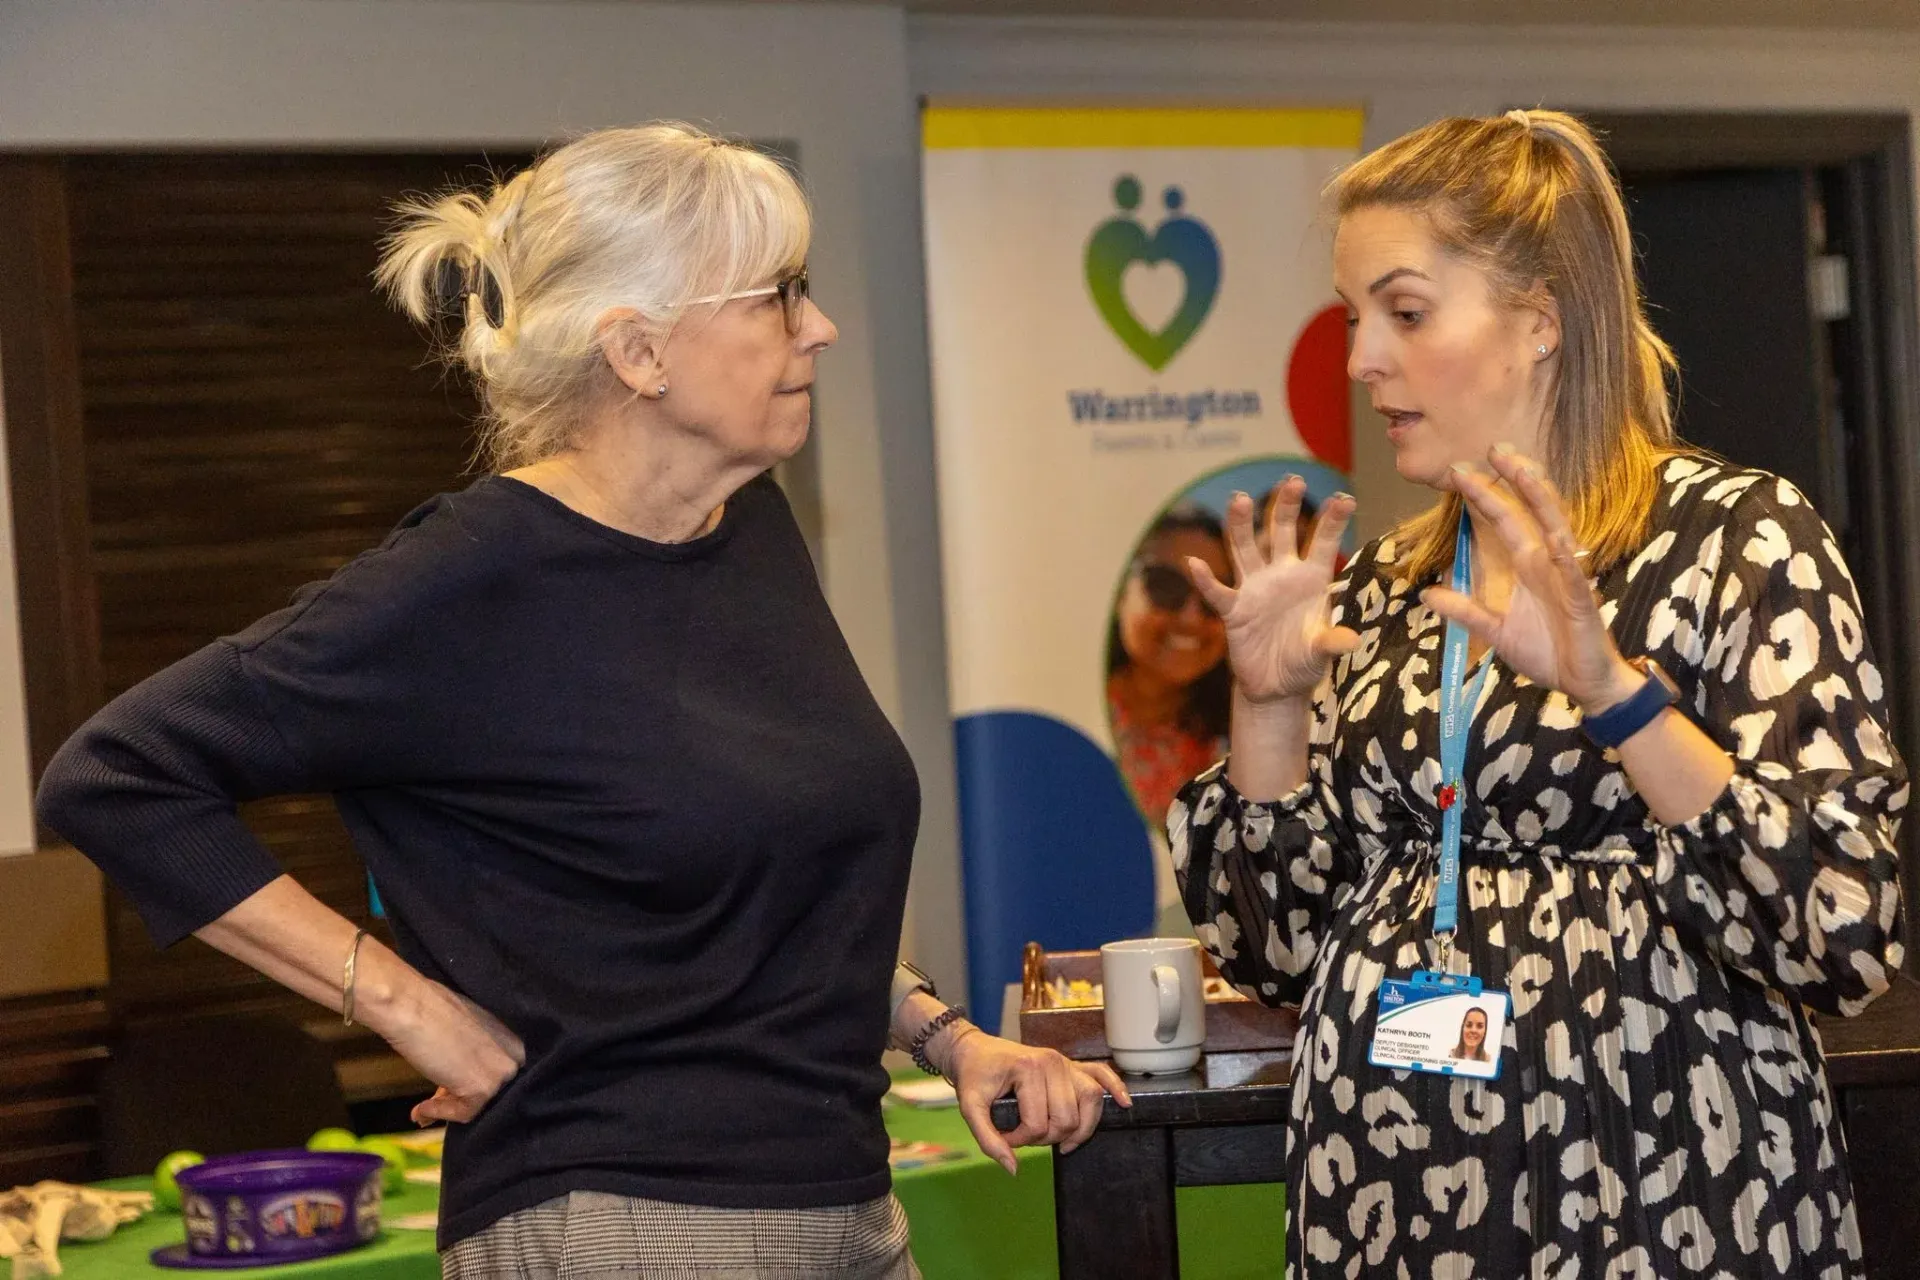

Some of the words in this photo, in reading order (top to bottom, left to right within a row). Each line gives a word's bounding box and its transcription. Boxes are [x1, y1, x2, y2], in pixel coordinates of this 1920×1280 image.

[1067, 387, 1261, 427] Warrington
[1445, 715, 1454, 736] NHS
[1447, 824, 1455, 856] Cheshire
[1444, 859, 1453, 882] NHS
[1377, 1027, 1407, 1036] KATHRYN
[1408, 1031, 1431, 1039] BOOTH
[1375, 1039, 1397, 1047] DEPUTY
[1397, 1042, 1430, 1050] DESIGNATED
[1375, 1045, 1397, 1053] CLINICAL
[1397, 1055, 1438, 1064] COMMISSIONING
